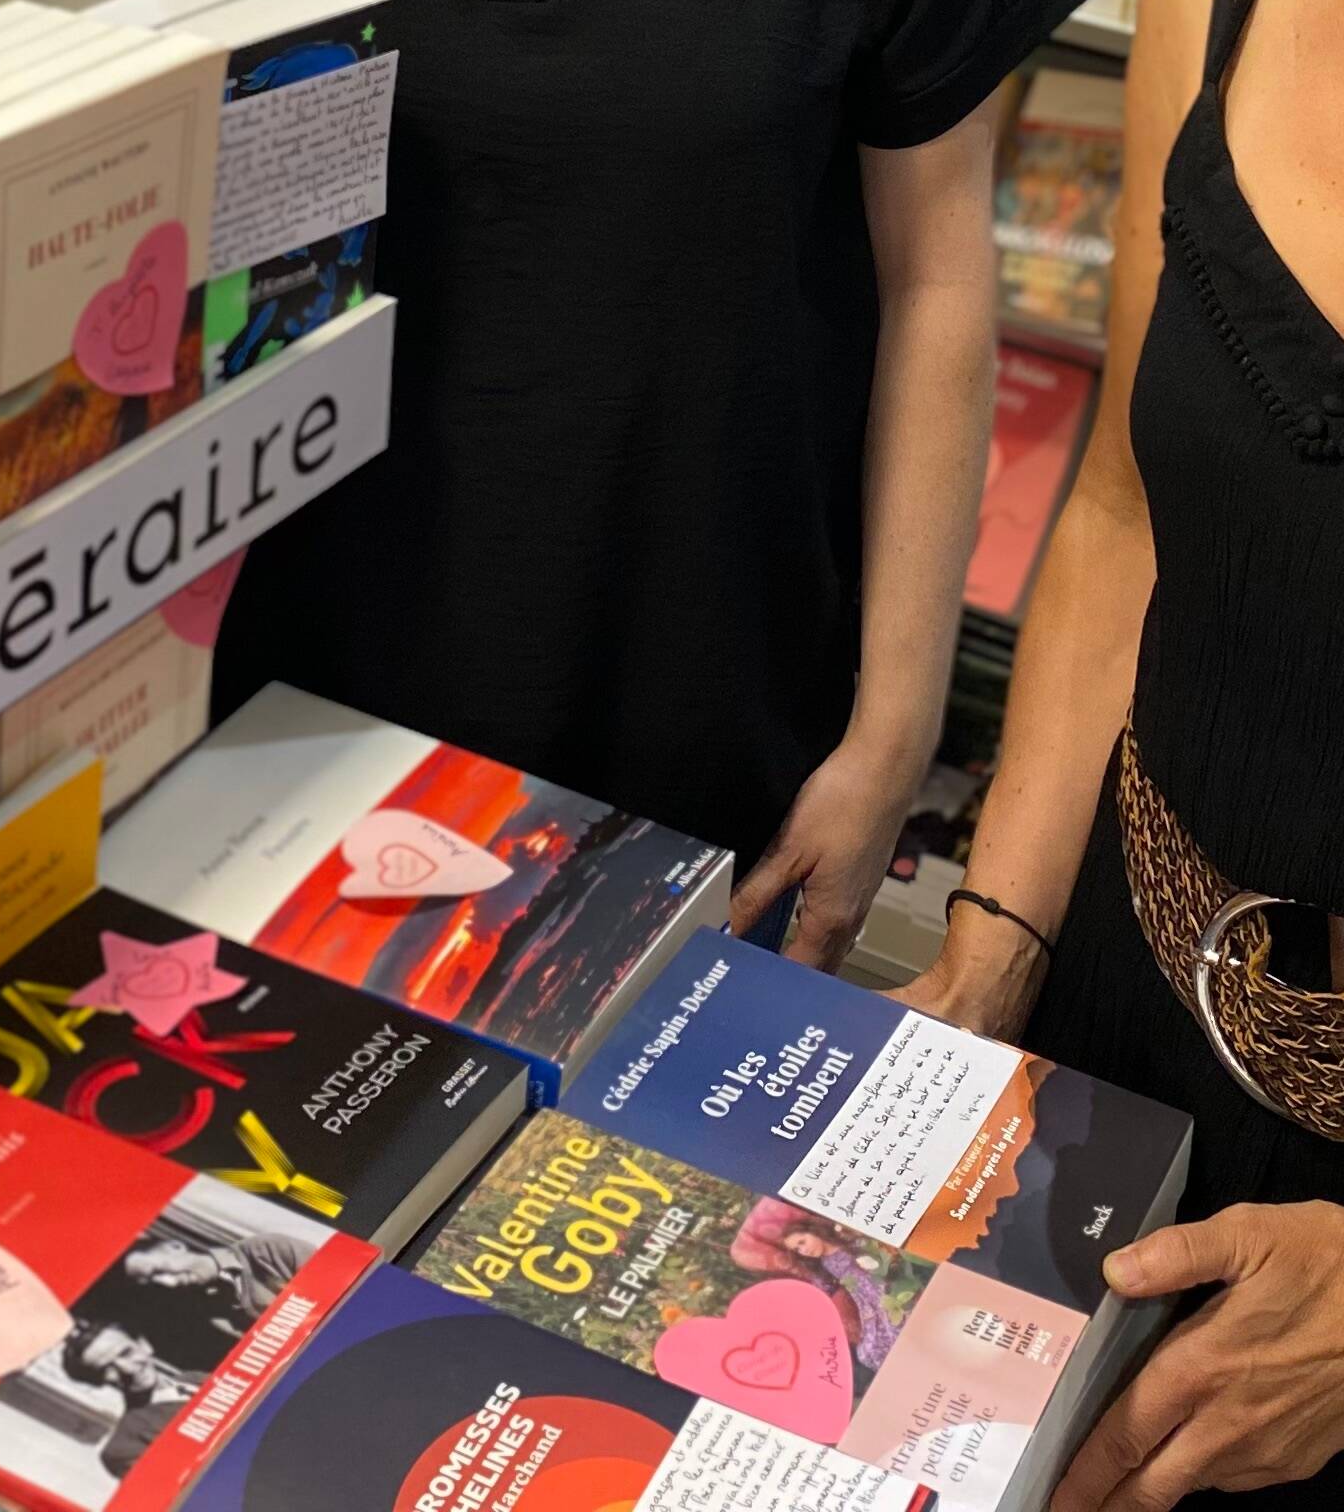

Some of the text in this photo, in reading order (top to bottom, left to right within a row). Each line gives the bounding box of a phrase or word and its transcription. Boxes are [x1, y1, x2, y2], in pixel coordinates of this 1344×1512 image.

[26, 183, 163, 271] HAUTE-FOLIE
[301, 1023, 401, 1120] ANTHONY
[440, 1056, 477, 1094] GRASSET
[601, 958, 732, 1113] Cédric Sapin-Defour
[757, 1024, 827, 1099] étoiles
[322, 1033, 432, 1135] PASSERON
[700, 1050, 768, 1121] Où les
[770, 1045, 855, 1141] tombent
[944, 1170, 963, 1193] Par
[948, 1199, 969, 1222] Son
[961, 1171, 987, 1209] odeur
[980, 1142, 1006, 1180] après
[1001, 1114, 1024, 1146] pluie
[440, 1132, 601, 1304] Valentine
[519, 1153, 675, 1295] Goby
[598, 1203, 696, 1321] LE PALMIER
[1081, 1201, 1115, 1240] Stock
[962, 1309, 988, 1337] Ren
[979, 1313, 1003, 1343] trée
[995, 1320, 1023, 1351] litté
[1014, 1321, 1040, 1356] raire
[1027, 1330, 1053, 1361] 2025
[176, 1292, 318, 1443] RENTRÉE LITTÉRAIRE
[413, 1382, 522, 1512] ROMESSES
[450, 1414, 536, 1512] HELINES
[890, 1382, 947, 1475] rtrait d'une
[920, 1392, 973, 1479] petite fille
[948, 1405, 999, 1483] en puzzle.
